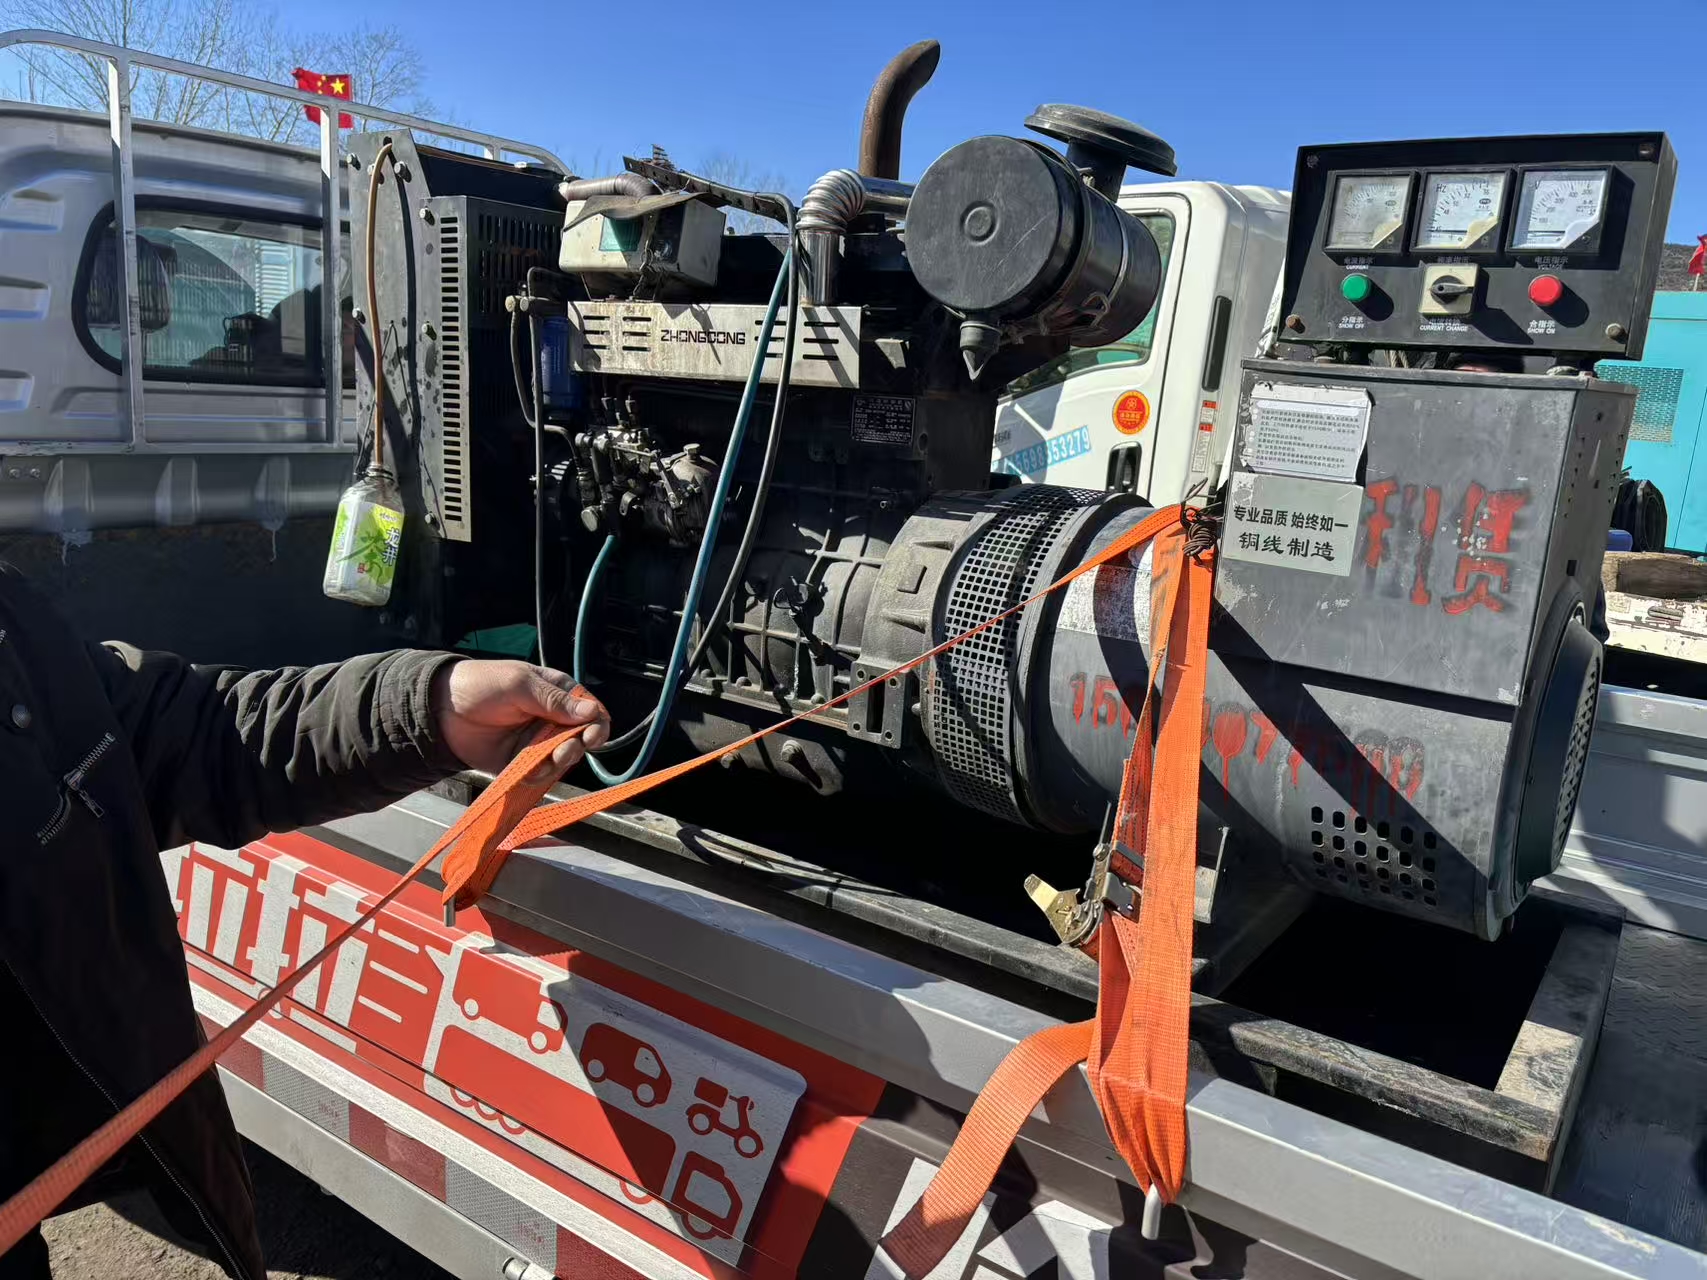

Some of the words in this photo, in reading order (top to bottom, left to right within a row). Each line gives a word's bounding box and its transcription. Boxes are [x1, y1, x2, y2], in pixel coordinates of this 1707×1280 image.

[1233, 505, 1288, 527] 专业品质
[1291, 511, 1349, 533] 始终如一
[1238, 531, 1335, 562] 铜线制造
